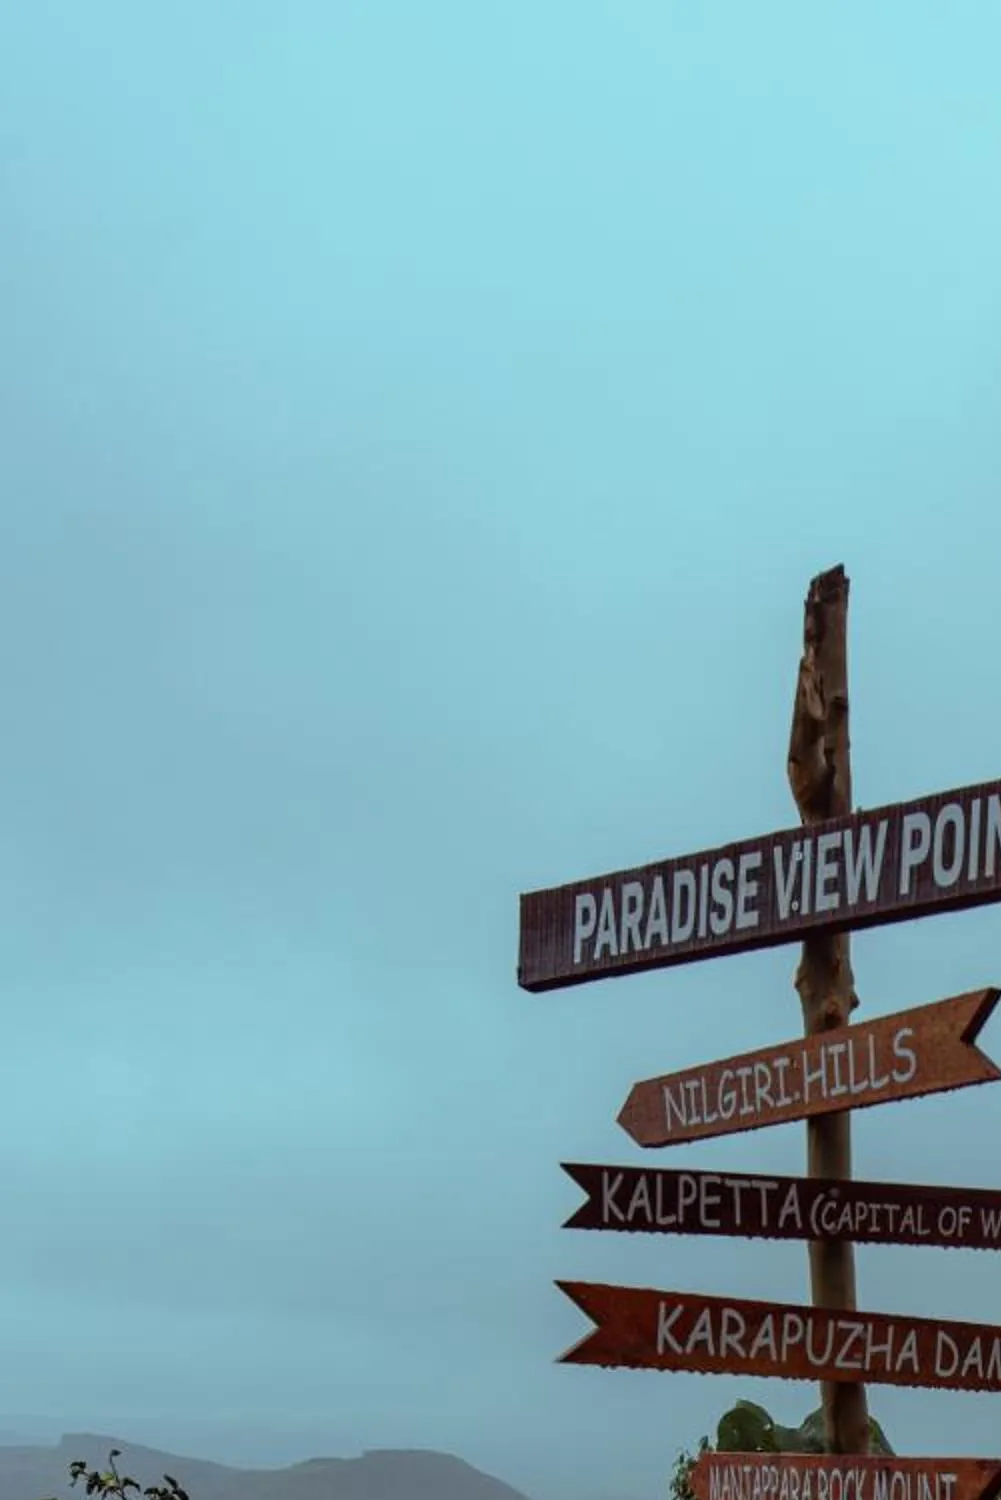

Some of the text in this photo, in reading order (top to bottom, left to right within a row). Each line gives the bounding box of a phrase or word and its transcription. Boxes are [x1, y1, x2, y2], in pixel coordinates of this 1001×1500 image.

[573, 851, 760, 965] PARADISE
[773, 819, 888, 920] VIEW
[803, 1028, 917, 1104] HILLS
[601, 1171, 803, 1229] KALPETTA
[811, 1192, 930, 1235] (CAPITAL
[939, 1206, 972, 1236] OF
[656, 1302, 920, 1375] KARAPUZHA
